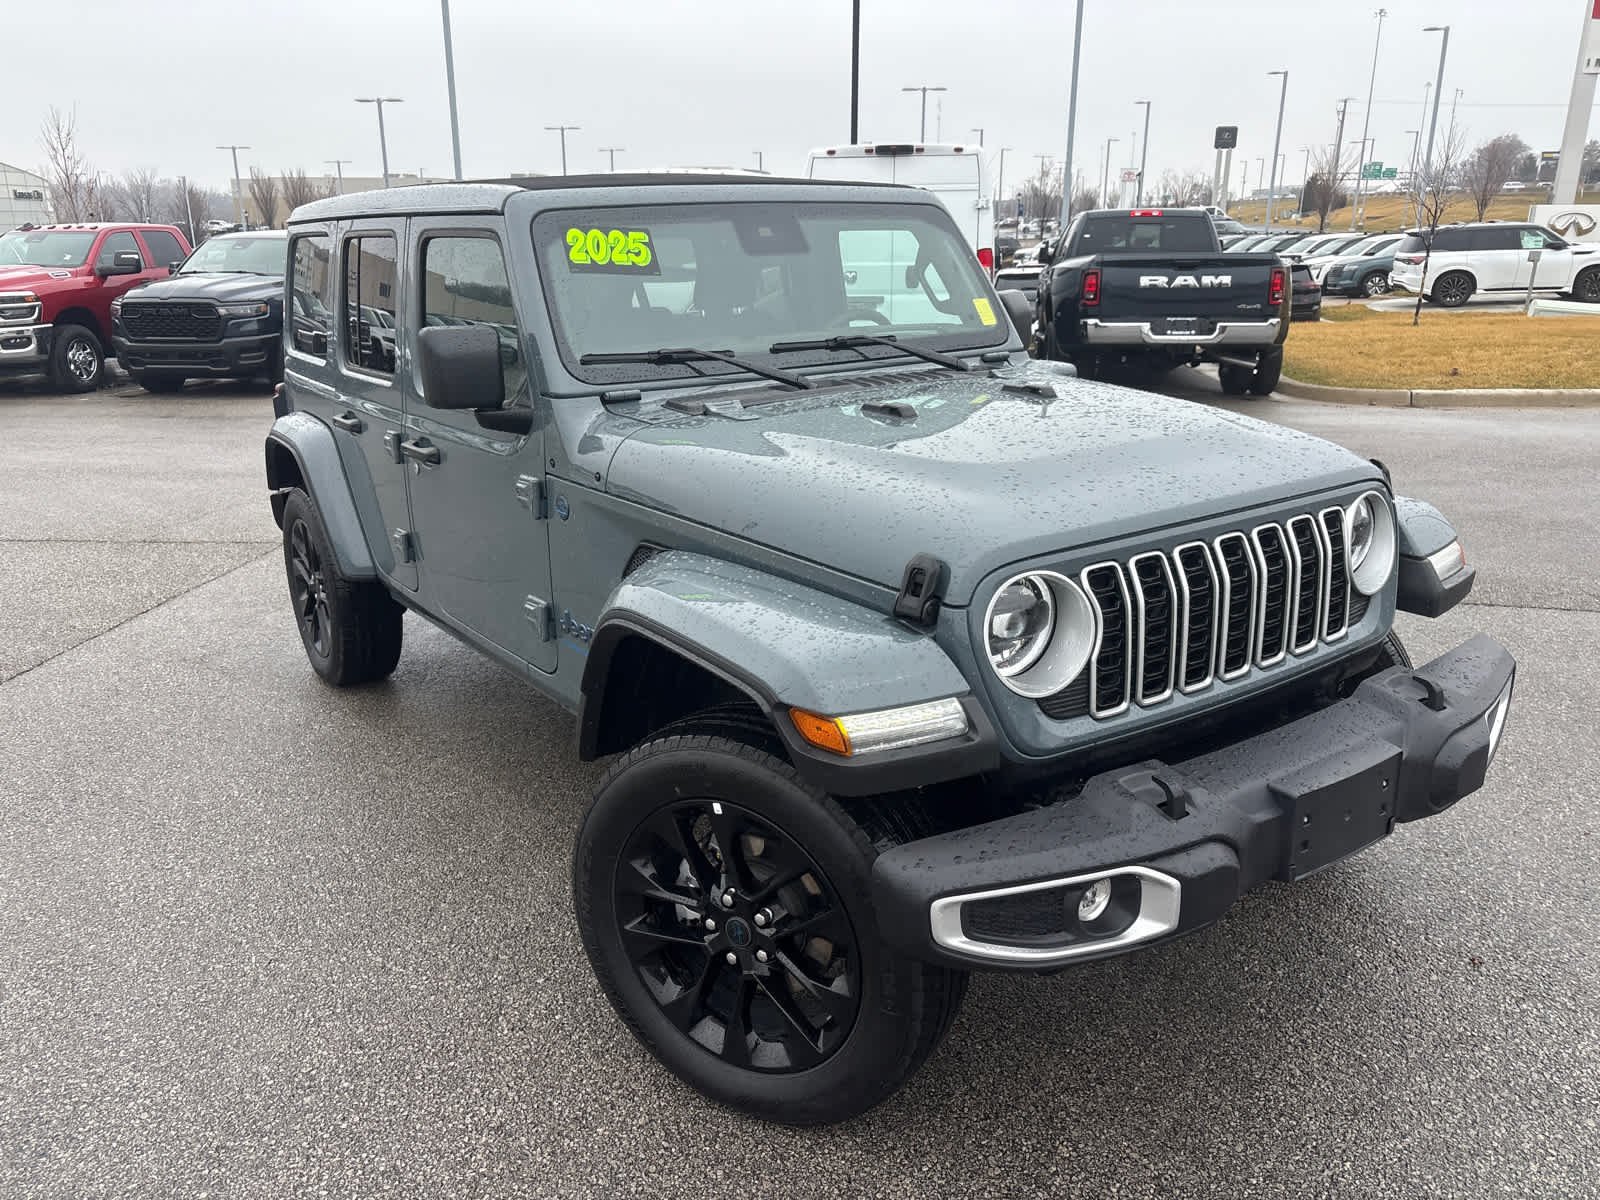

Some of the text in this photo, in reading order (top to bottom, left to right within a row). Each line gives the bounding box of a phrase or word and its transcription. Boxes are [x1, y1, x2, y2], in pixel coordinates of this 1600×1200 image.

[33, 190, 43, 201] City
[566, 228, 652, 267] 2025
[1139, 275, 1232, 288] RAM
